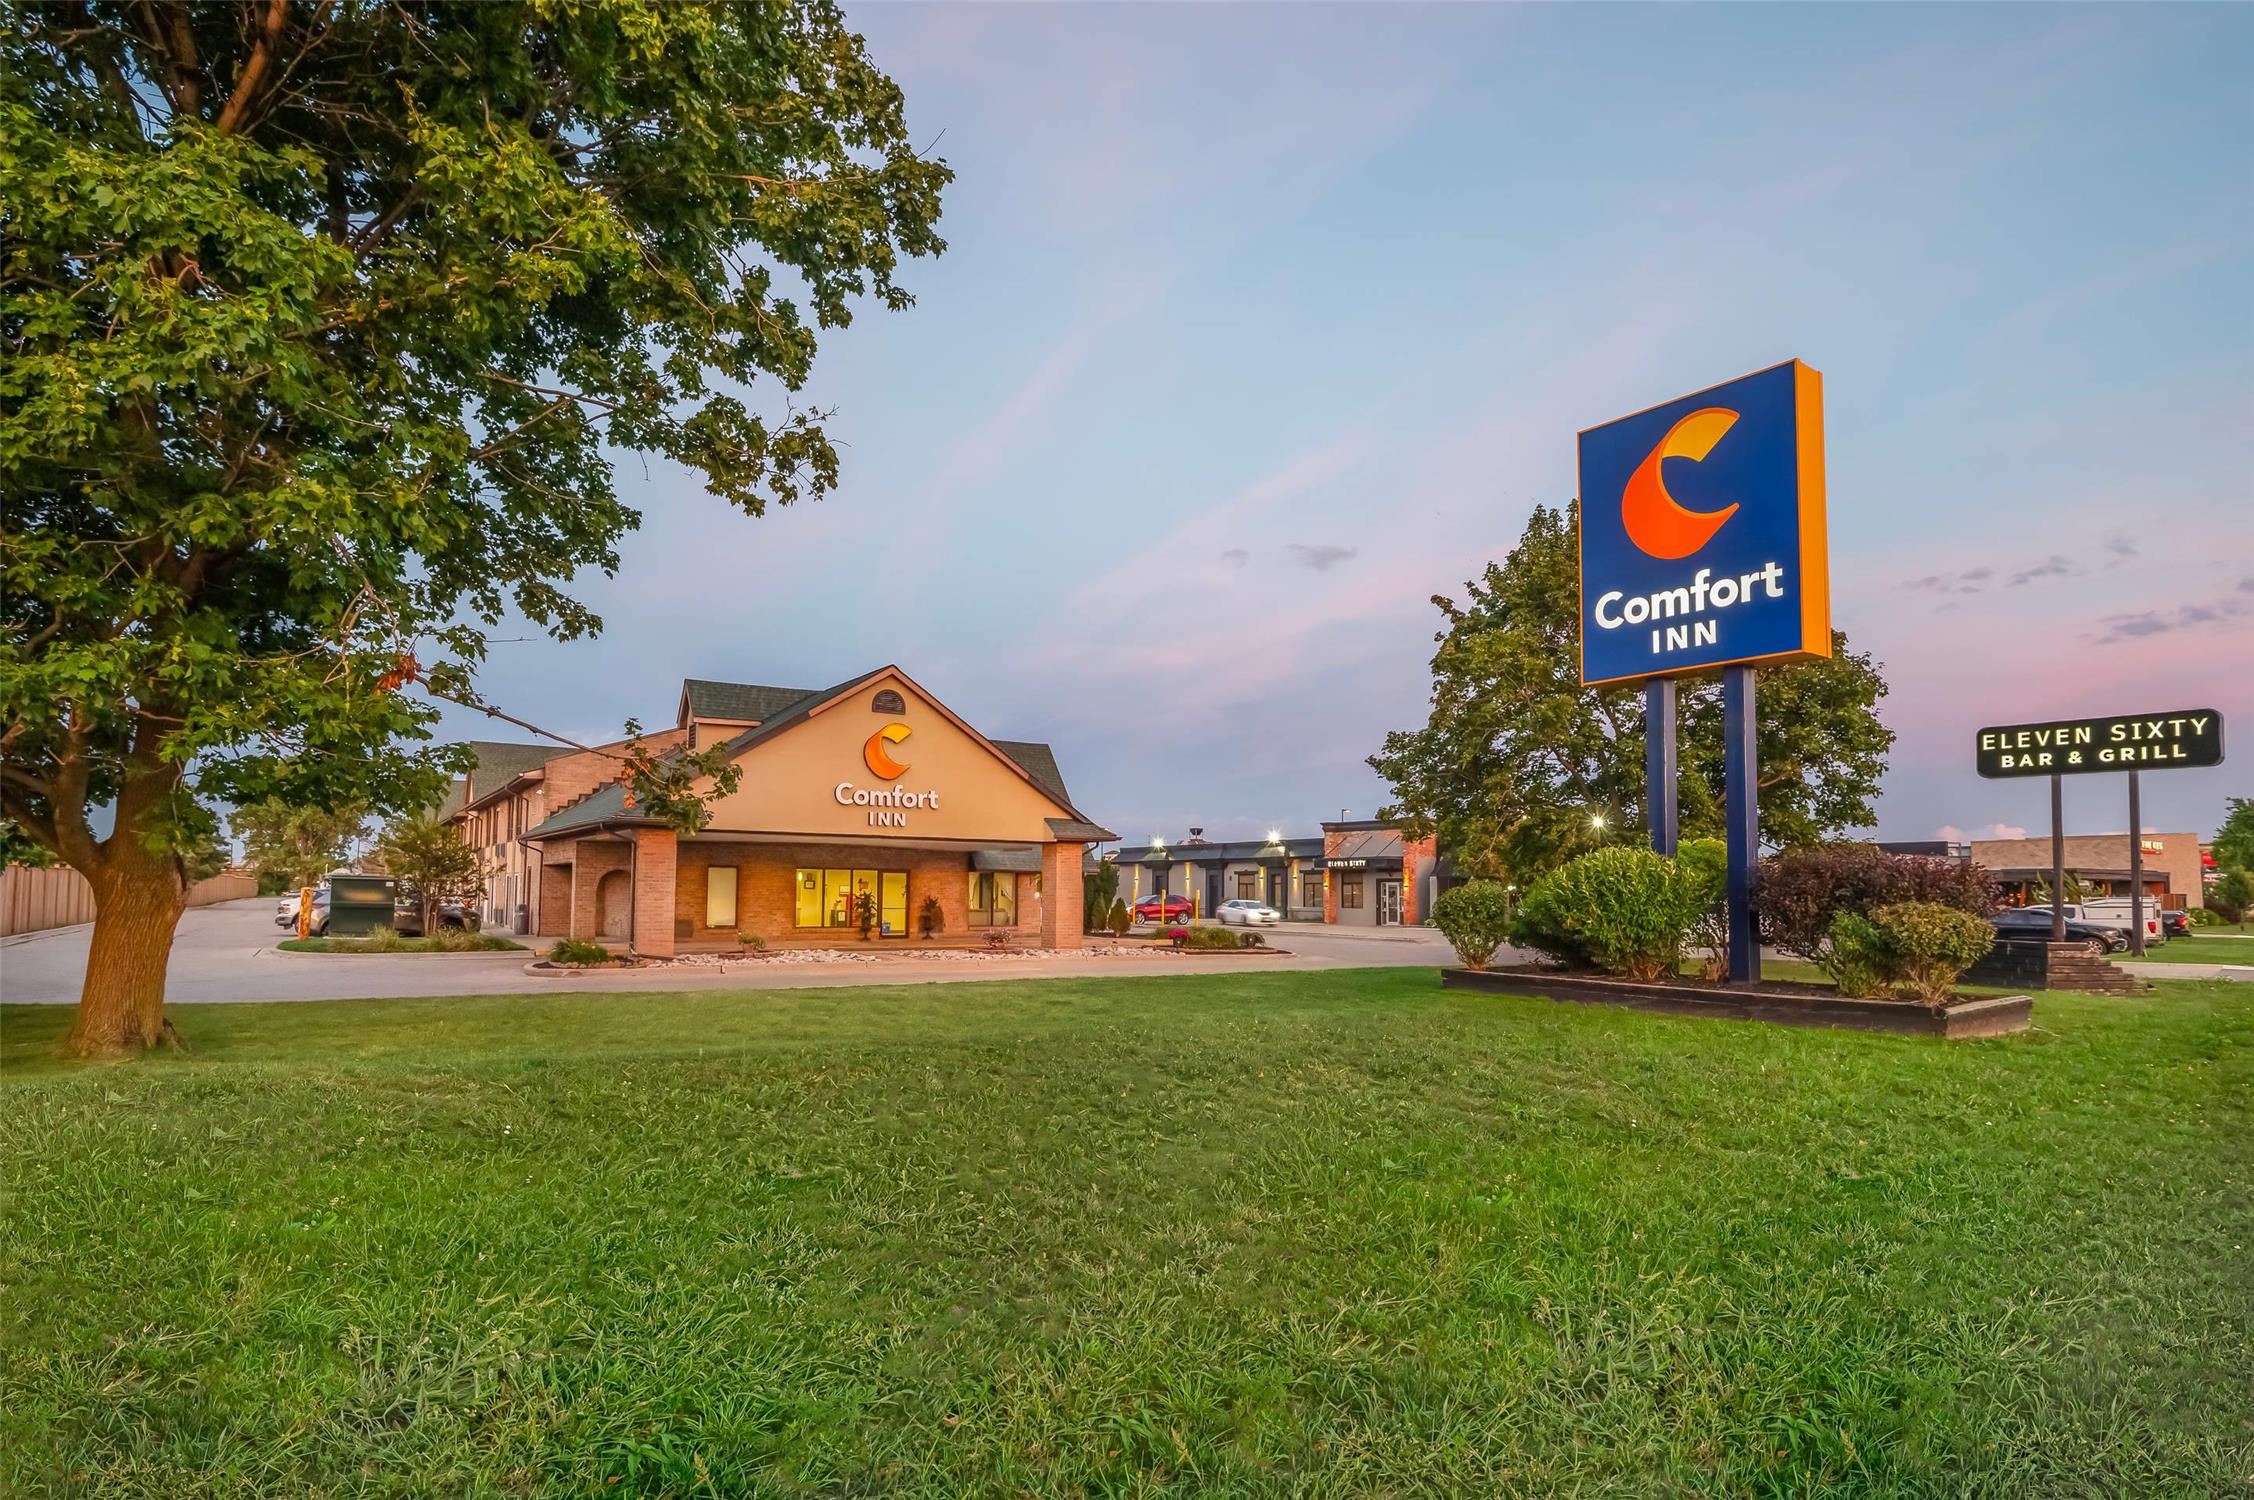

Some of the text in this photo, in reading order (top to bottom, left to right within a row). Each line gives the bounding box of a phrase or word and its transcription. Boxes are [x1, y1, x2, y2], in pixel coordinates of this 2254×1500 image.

[1595, 562, 1784, 630] Comfort
[1652, 620, 1717, 654] INN
[1982, 717, 2208, 750] ELEVEN SIXTY
[2001, 744, 2187, 768] BAR & GRILL
[834, 782, 939, 809] Comfort
[868, 811, 906, 826] INN
